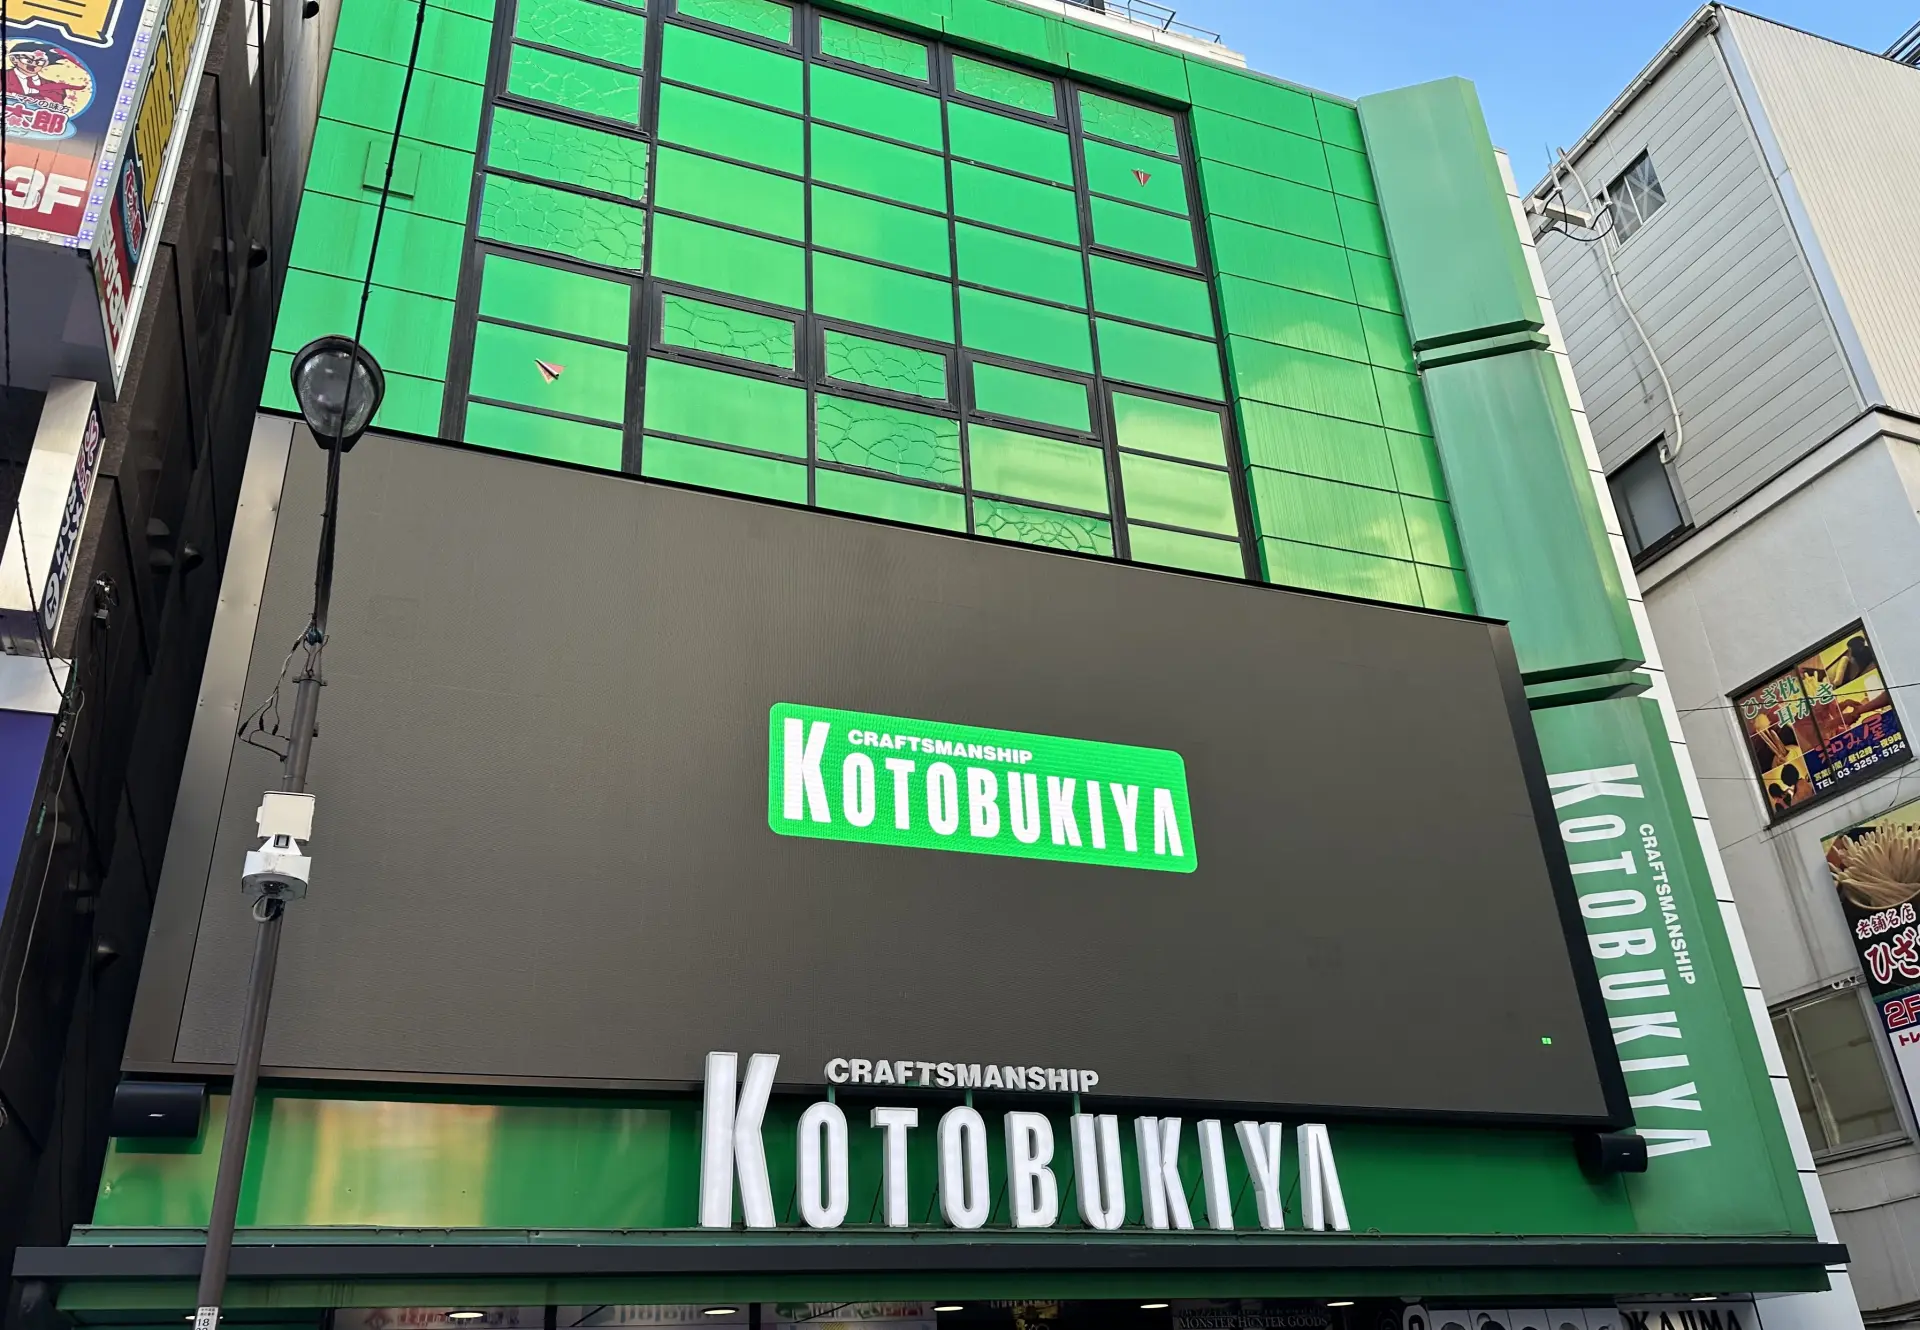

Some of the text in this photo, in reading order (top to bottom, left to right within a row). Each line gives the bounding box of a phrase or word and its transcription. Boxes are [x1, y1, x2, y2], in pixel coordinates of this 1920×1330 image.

[47, 581, 57, 617] 2F
[1741, 675, 1800, 719] ひざ枕
[1776, 683, 1834, 728] 耳かき
[848, 729, 1033, 764] CRAFTSMANSHIP
[784, 717, 1185, 857] KOTOBUKIYA
[1816, 777, 1835, 790] TEL
[1638, 823, 1695, 985] CRAFTSMANSHIP
[1856, 903, 1917, 939] 老舗名店
[1547, 764, 1711, 1158] KOTOBUKIYA
[1864, 925, 1920, 984] ひざ
[1884, 993, 1920, 1029] 2F
[825, 1057, 1099, 1092] CRAFTSMANSHIP
[702, 1051, 1350, 1232] KOTOBUKIYA
[198, 1318, 210, 1327] 18
[1179, 1316, 1328, 1329] MONSTER HUNTER GOODS
